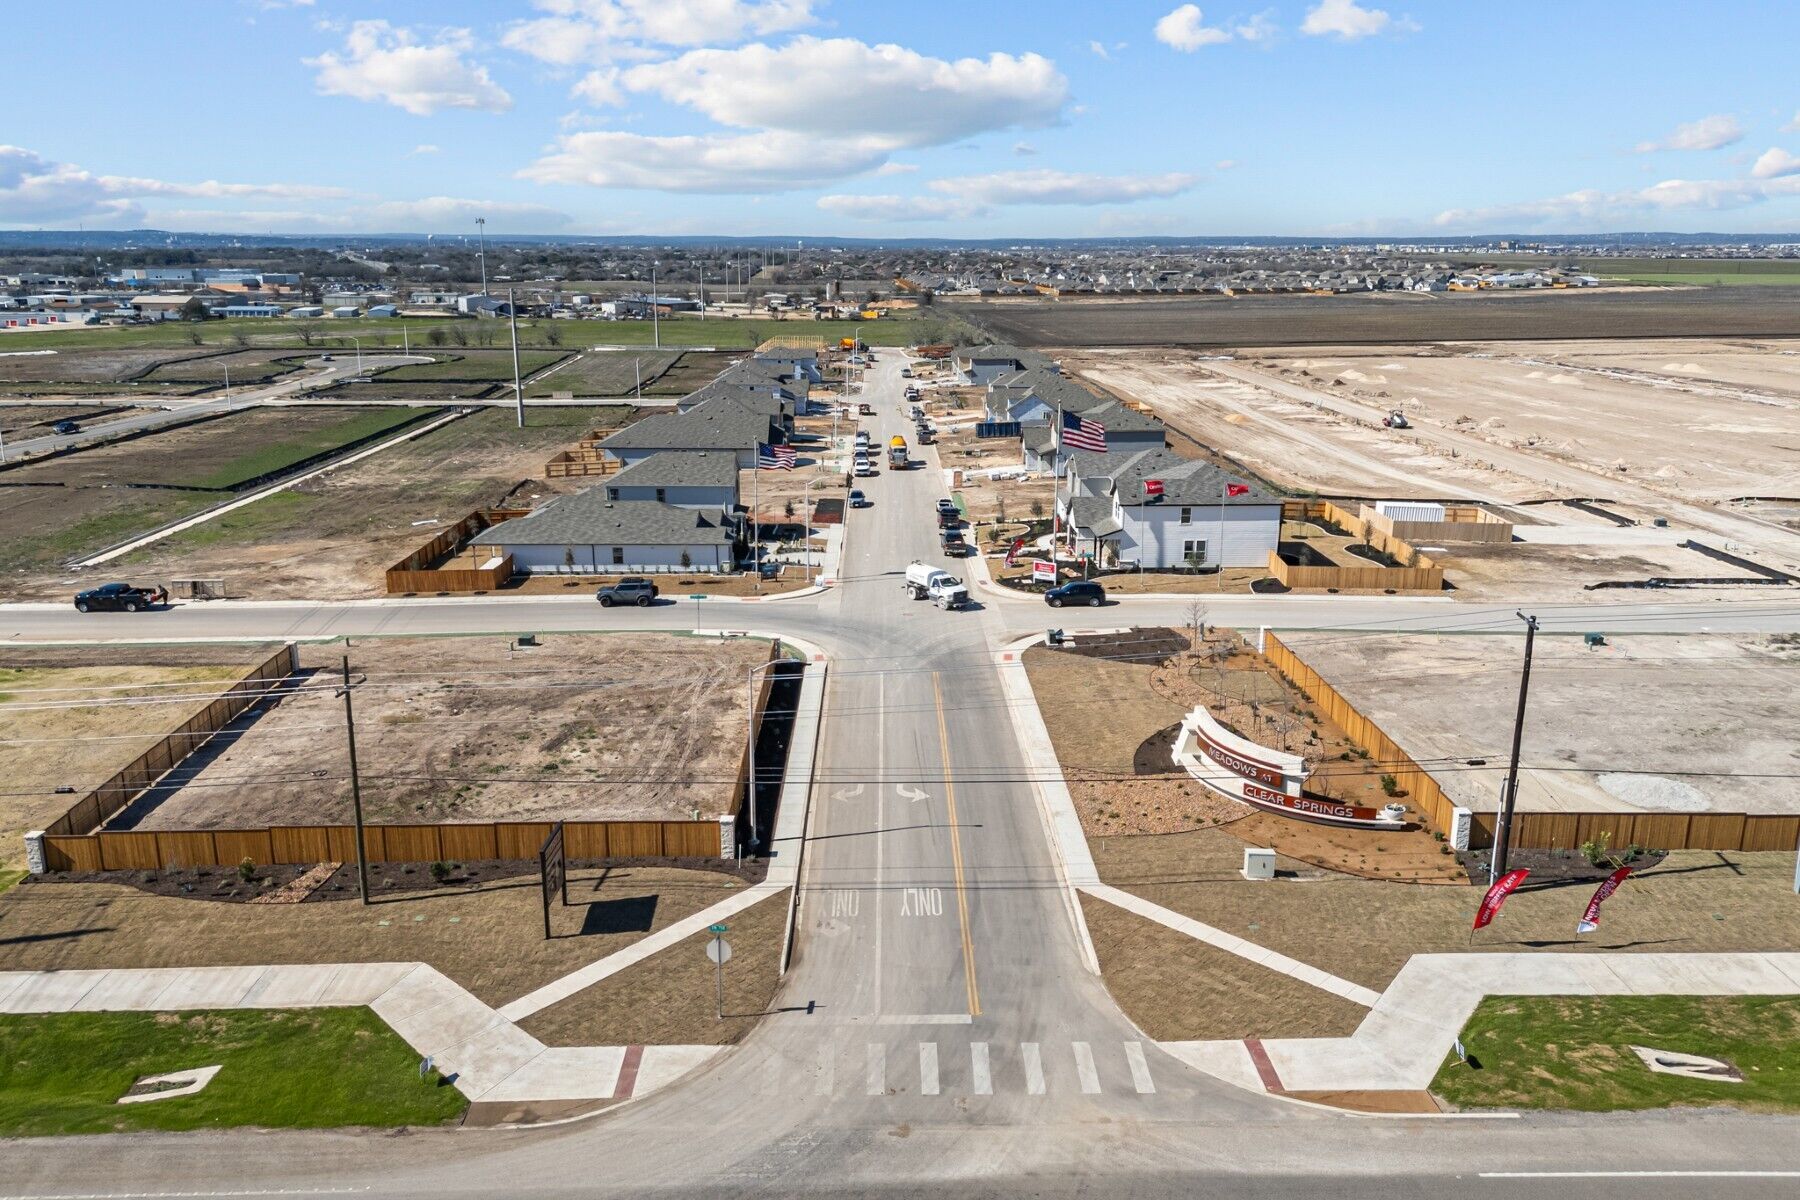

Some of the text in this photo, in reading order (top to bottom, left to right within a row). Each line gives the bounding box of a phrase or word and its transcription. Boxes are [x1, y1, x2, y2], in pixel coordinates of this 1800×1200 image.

[1208, 746, 1272, 782] MEADOWS AT
[1245, 787, 1353, 817] CLEAR SPRINGS
[901, 888, 943, 917] ONLY
[1585, 903, 1598, 921] NEW
